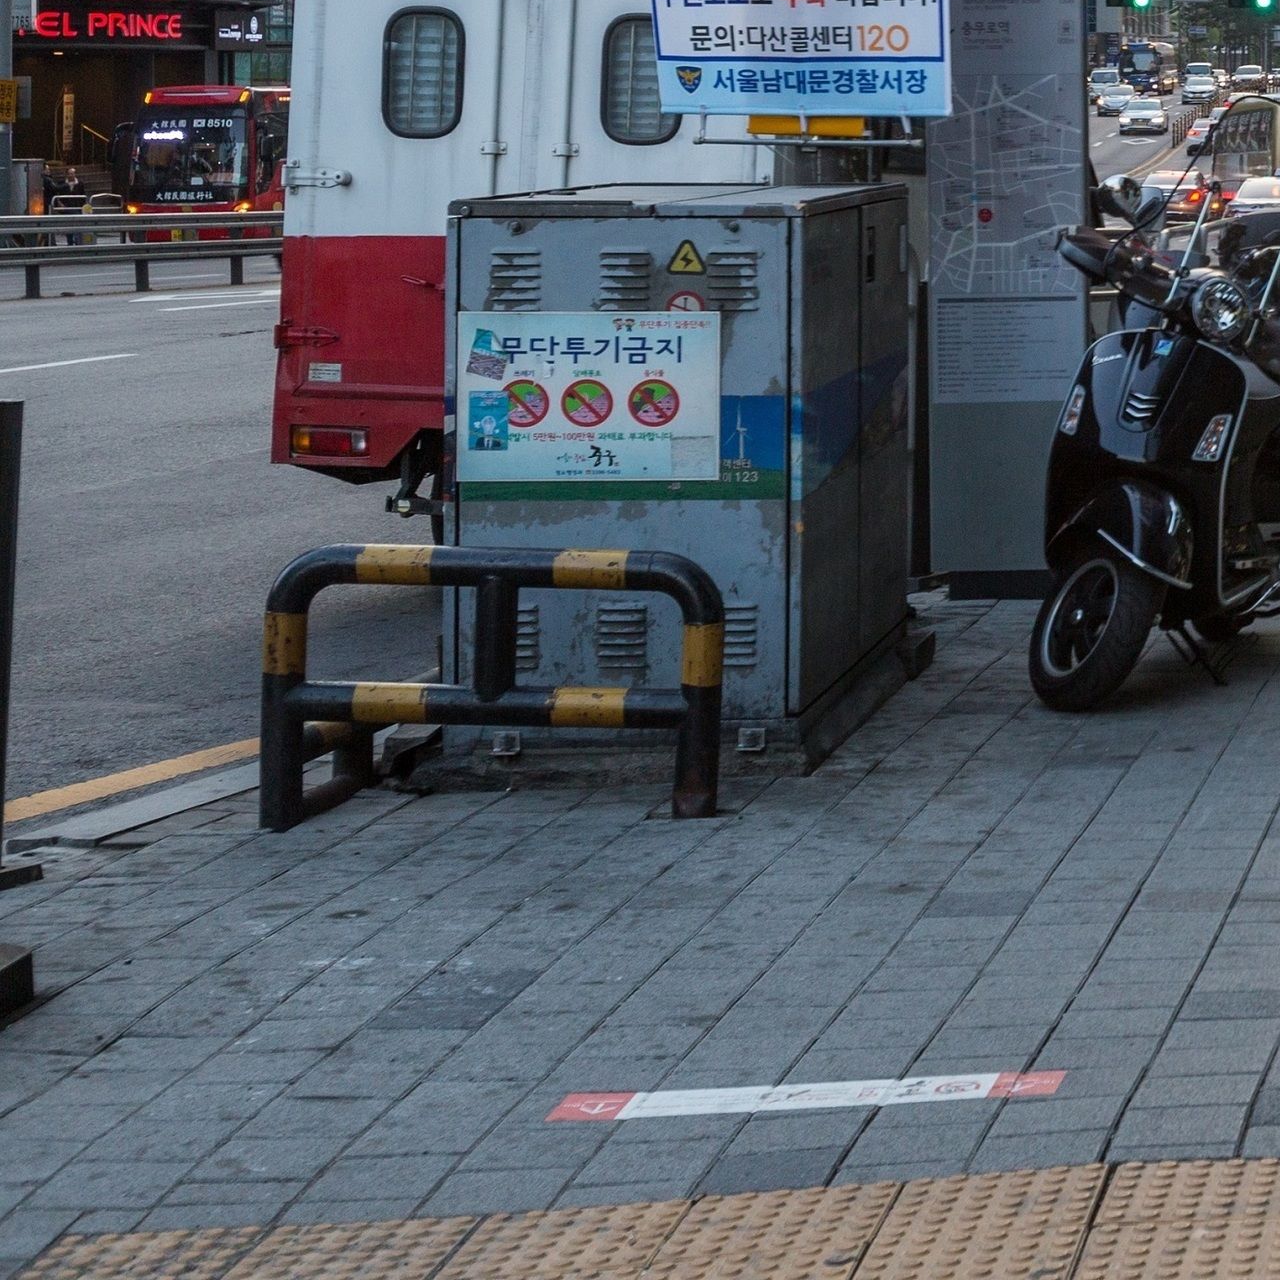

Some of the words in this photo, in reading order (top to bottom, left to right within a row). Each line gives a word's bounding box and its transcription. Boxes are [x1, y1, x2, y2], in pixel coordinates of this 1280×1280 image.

[18, 12, 78, 37] EL
[88, 12, 183, 39] PRINCE
[961, 21, 1009, 35] 충무로역
[713, 69, 927, 94] 서울남대문경찰서장
[207, 119, 233, 128] 8510
[639, 320, 671, 329] 무단투기
[502, 336, 682, 365] 무단투기금지
[735, 472, 759, 482] 123
